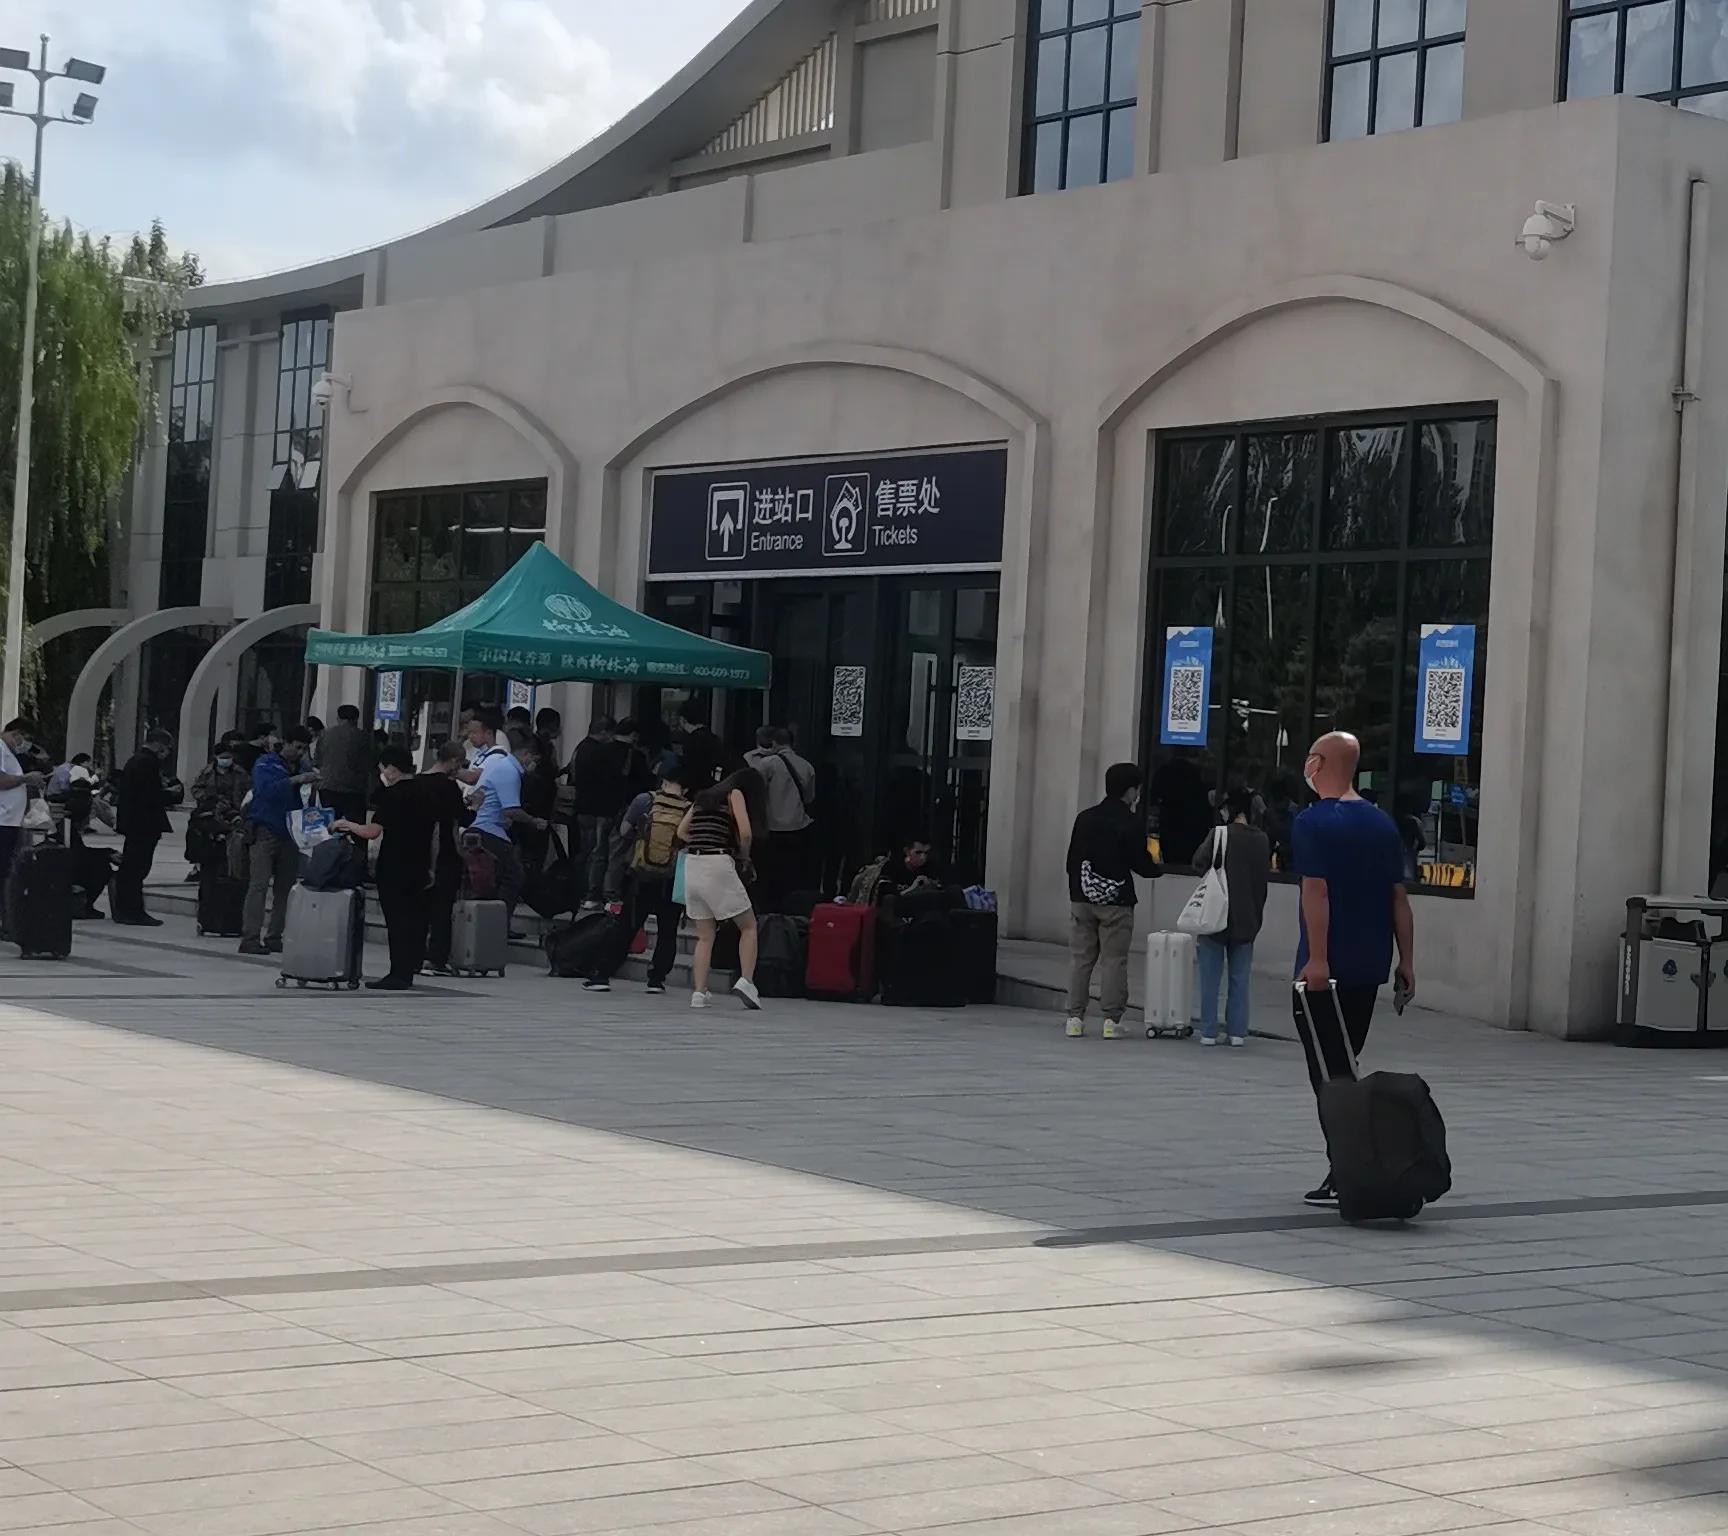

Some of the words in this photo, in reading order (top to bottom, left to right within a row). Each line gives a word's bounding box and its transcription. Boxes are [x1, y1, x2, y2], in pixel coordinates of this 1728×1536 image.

[753, 485, 814, 525] 进站口
[874, 475, 941, 519] 售票处
[750, 532, 804, 552] Entrance
[871, 524, 918, 547] Tickets
